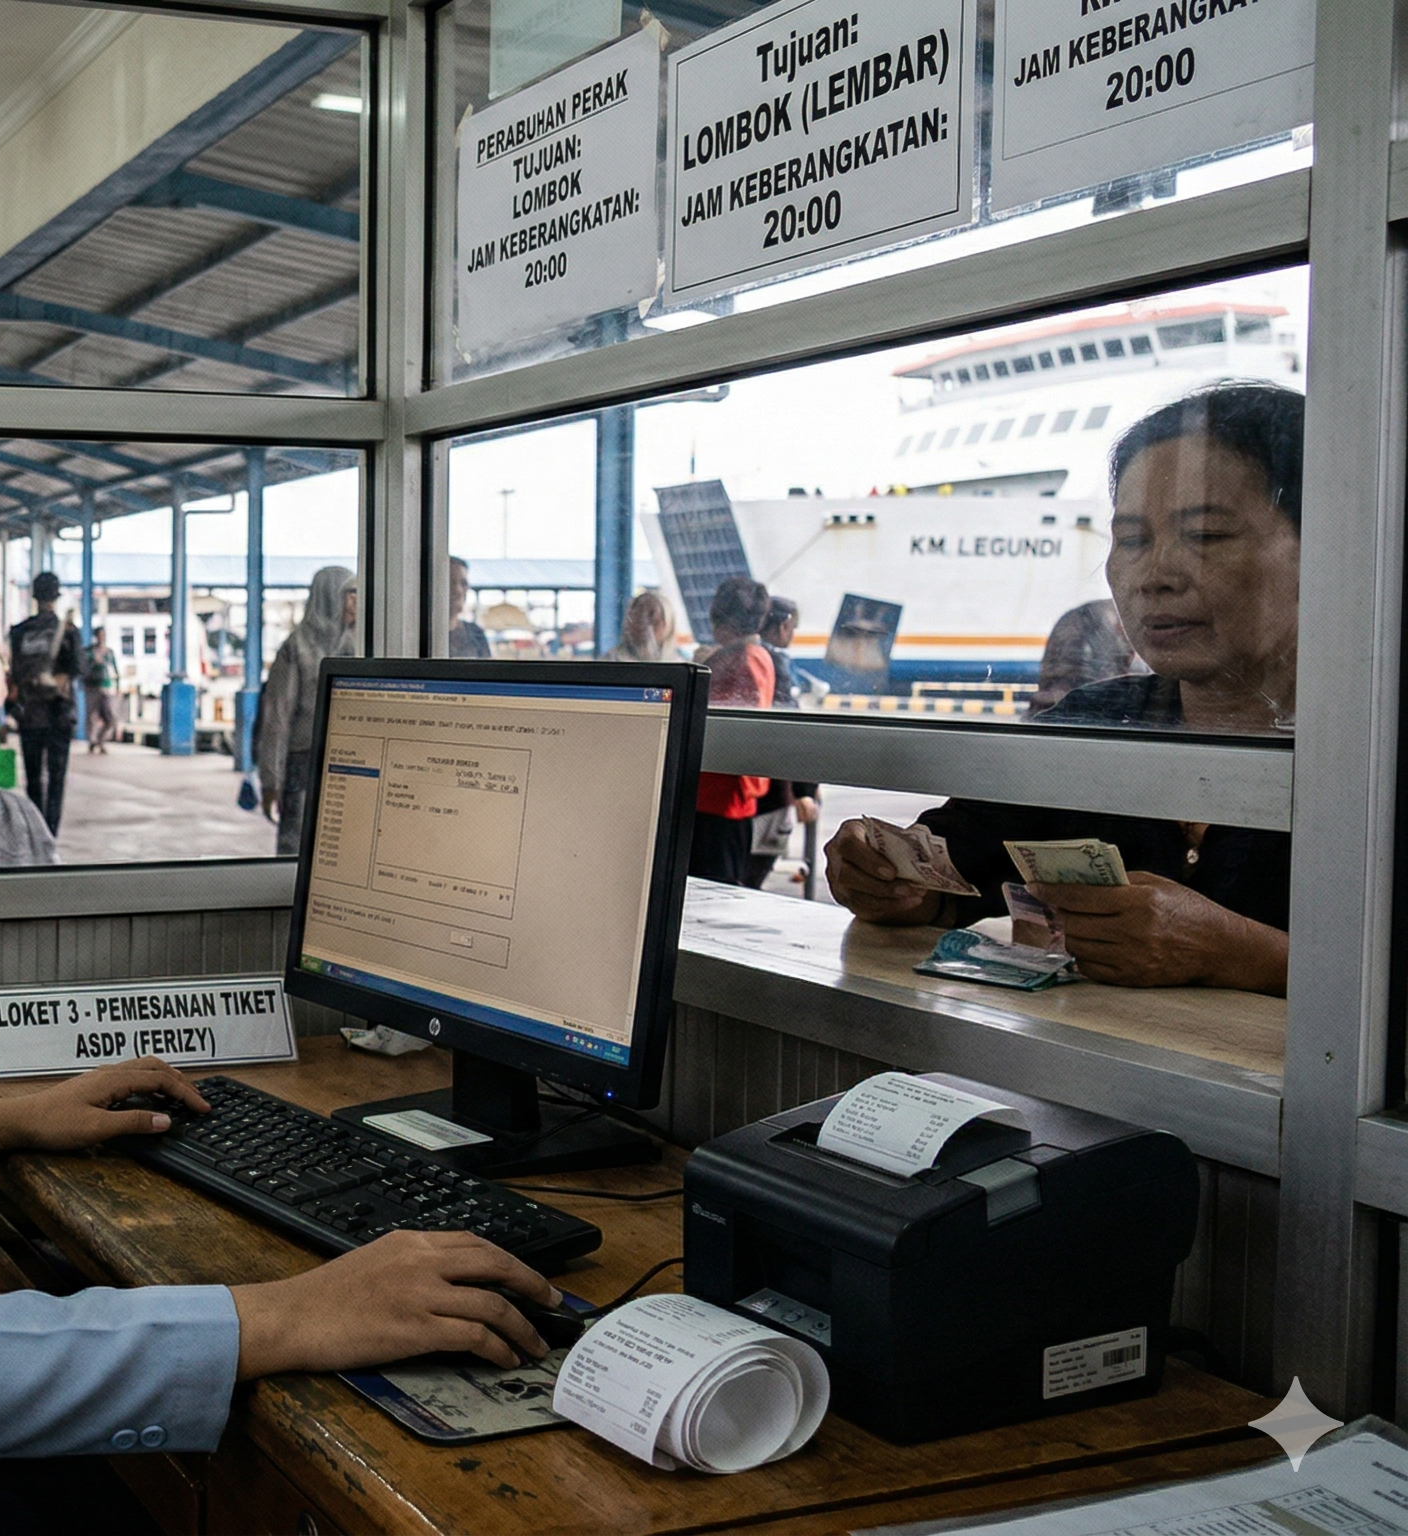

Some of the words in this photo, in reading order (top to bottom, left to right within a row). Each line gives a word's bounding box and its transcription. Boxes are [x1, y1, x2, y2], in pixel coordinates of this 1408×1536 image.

[757, 13, 859, 82] Tujuan:
[1013, 45, 1061, 86] JAM
[1067, 0, 1258, 68] KEBERANGK
[682, 92, 793, 171] LOMBOK
[802, 28, 950, 135] (LEMBAR)
[1105, 47, 1196, 110] 20:00
[477, 99, 567, 163] PERABUHAN
[571, 69, 629, 122] PERAK
[513, 135, 582, 184] TUJUAN:
[681, 194, 723, 227] JAM
[729, 107, 949, 211] KEBERANGKATAN:
[512, 170, 582, 219] LOMBOK
[763, 190, 842, 249] 20:00
[467, 243, 495, 273] JAM
[499, 188, 640, 259] KEBERANGKATAN:
[525, 252, 567, 288] 20:00
[957, 536, 1062, 557] LEGUNDI
[68, 999, 79, 1023] 3
[96, 992, 217, 1022] PEMESANAN
[220, 989, 276, 1015] TIKET
[76, 1032, 127, 1058] ASDP
[133, 1027, 217, 1058] (FERIZY)
